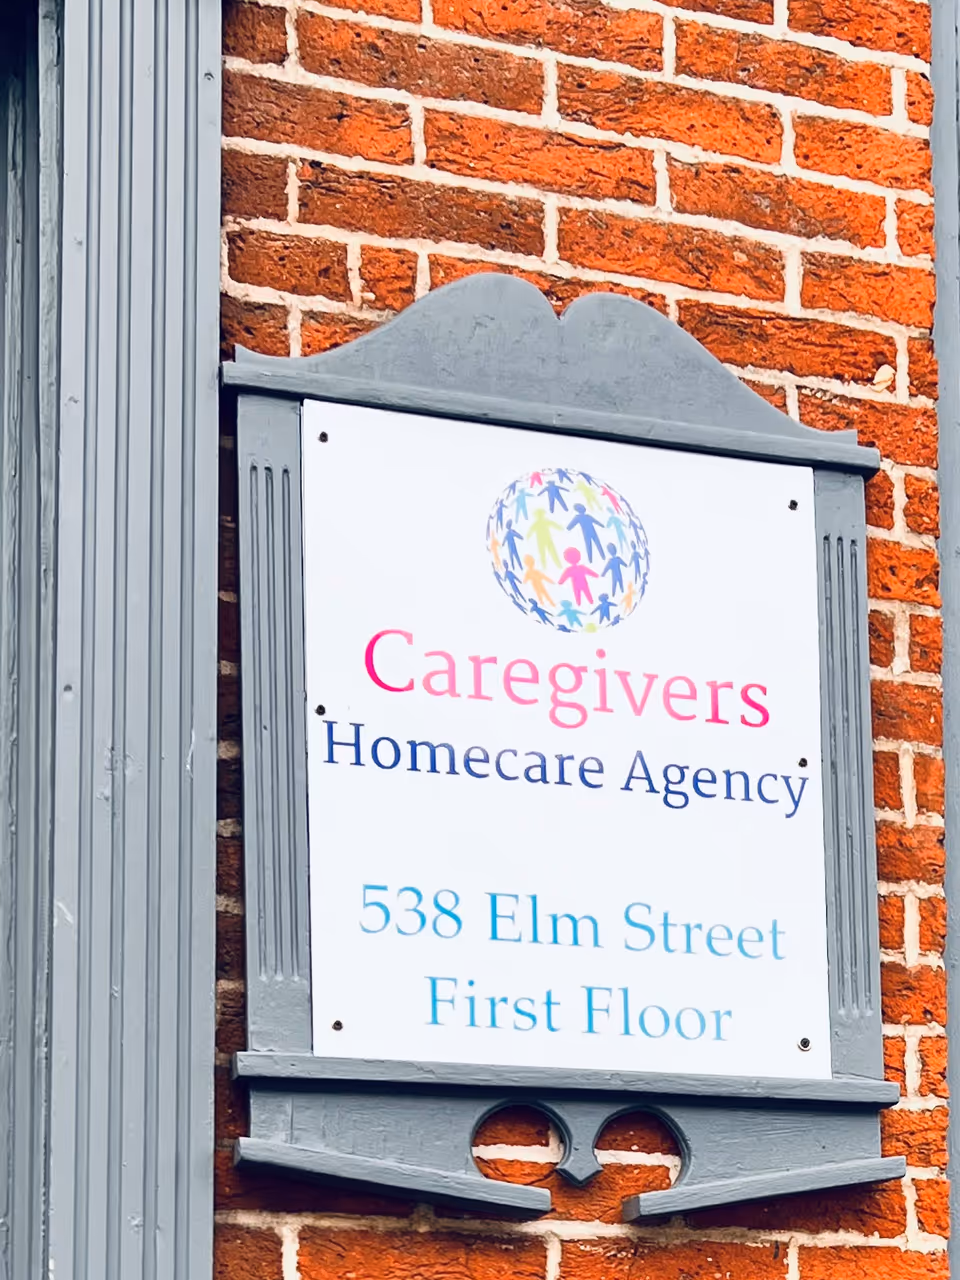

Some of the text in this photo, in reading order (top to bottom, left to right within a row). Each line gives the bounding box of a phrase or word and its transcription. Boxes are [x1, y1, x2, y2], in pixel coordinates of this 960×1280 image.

[364, 628, 771, 729] Caregivers
[322, 719, 810, 819] Homecare Agency
[358, 883, 787, 961] 538 Elm Street
[424, 975, 733, 1041] First Floor
